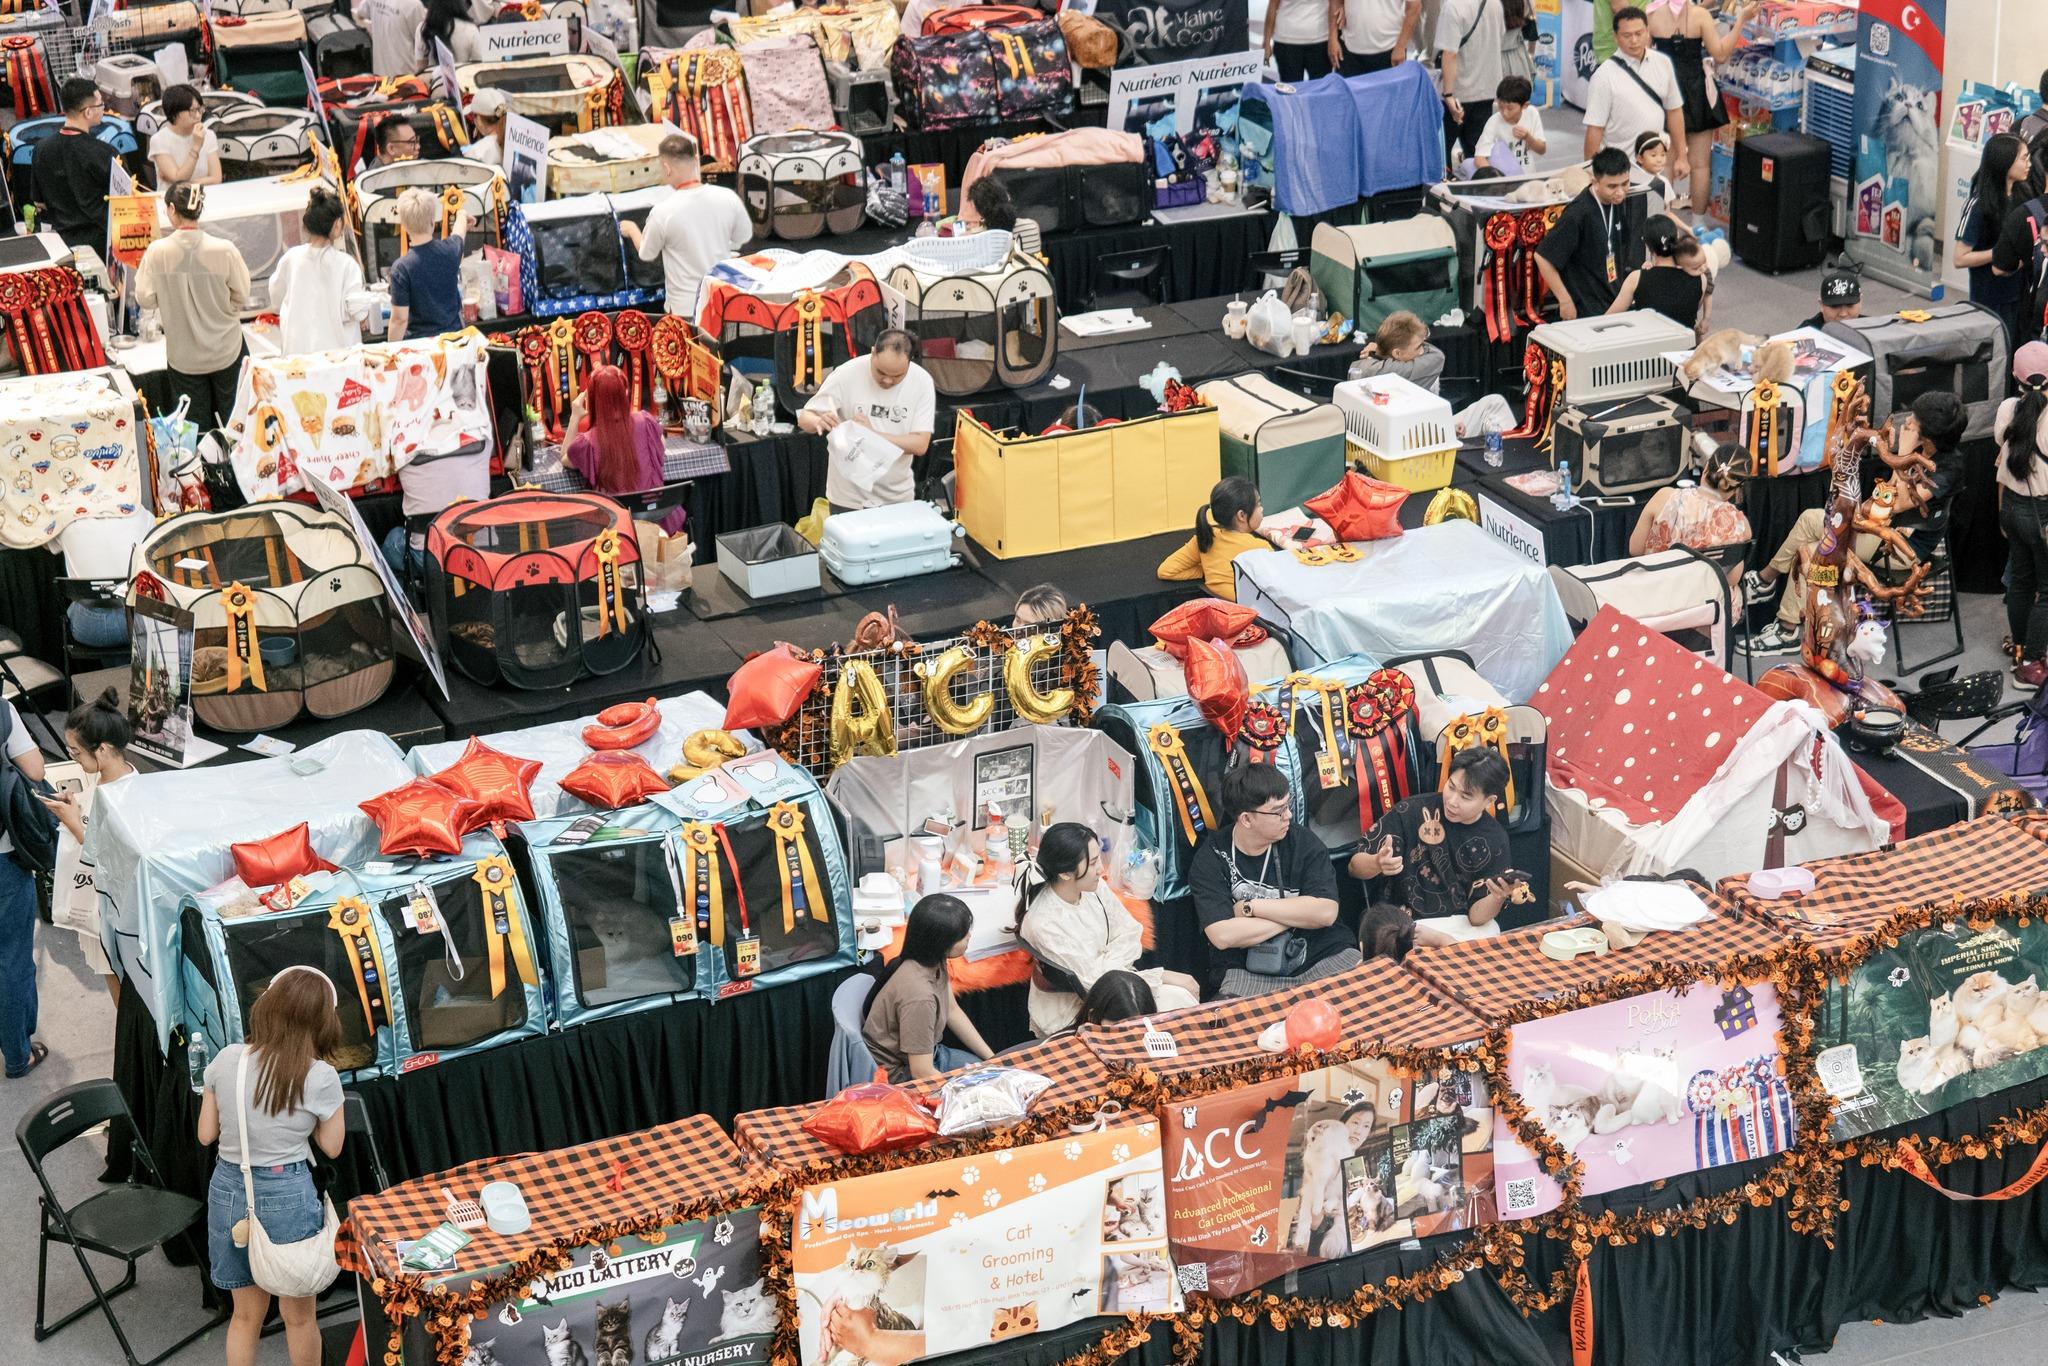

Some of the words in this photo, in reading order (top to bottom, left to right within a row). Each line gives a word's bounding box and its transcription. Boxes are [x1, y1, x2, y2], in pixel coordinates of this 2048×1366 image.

[489, 31, 562, 50] Nutrience
[1117, 73, 1182, 94] Nutrienc
[1187, 62, 1258, 85] Nutrience
[508, 129, 545, 153] Nutrience
[685, 415, 710, 426] WILD
[1486, 514, 1539, 562] Nutrience
[676, 933, 693, 942] 090
[740, 954, 757, 963] 073
[1941, 948, 1978, 966] IMPERIAL
[1966, 949, 2001, 964] CATTERY
[1170, 1120, 1262, 1183] ACC
[1174, 1199, 1221, 1220] Advanced
[1222, 1181, 1272, 1207] Professional
[1198, 1217, 1214, 1229] Cat
[1217, 1202, 1256, 1224] Grooming
[1006, 1223, 1033, 1242] Cat
[982, 1247, 1054, 1269] Grooming
[990, 1276, 1001, 1290] &
[1007, 1268, 1045, 1289] Hotel
[684, 1342, 755, 1366] NURSERY
